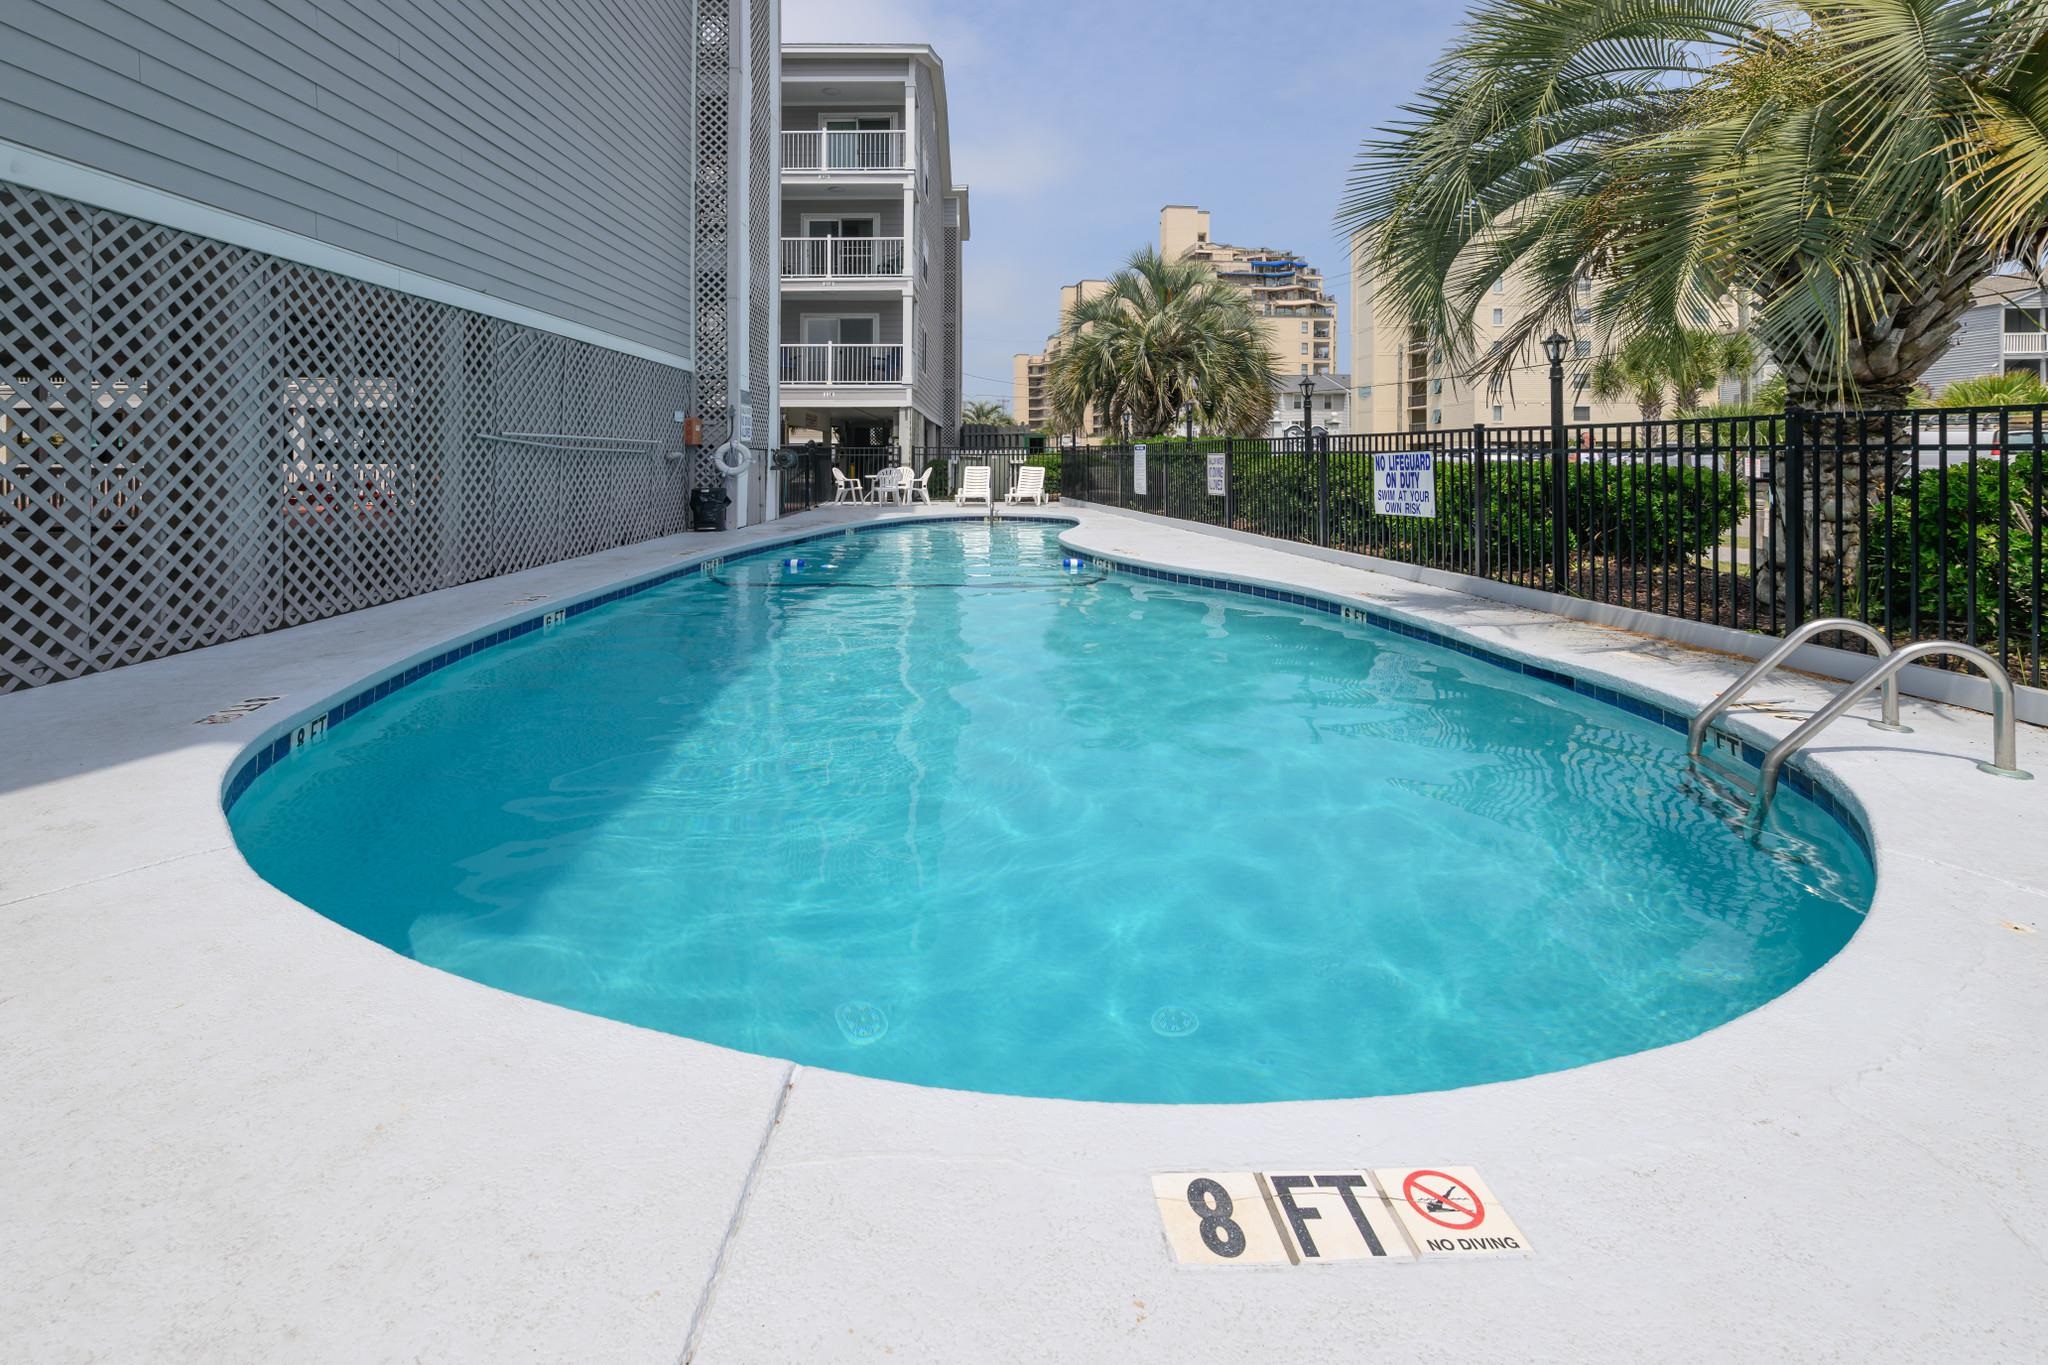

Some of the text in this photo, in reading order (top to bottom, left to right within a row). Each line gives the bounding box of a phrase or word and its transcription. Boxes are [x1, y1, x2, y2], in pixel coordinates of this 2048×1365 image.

[1375, 453, 1431, 471] NO LIFEGUARD
[1385, 471, 1420, 489] ON DUTY
[1377, 489, 1430, 503] SWIM AT YOUR
[1384, 501, 1421, 515] OWN RISK
[1354, 609, 1366, 622] FT
[310, 714, 327, 740] FT
[1187, 1174, 1388, 1258] 8 FT
[1425, 1236, 1521, 1252] NO DIVING
